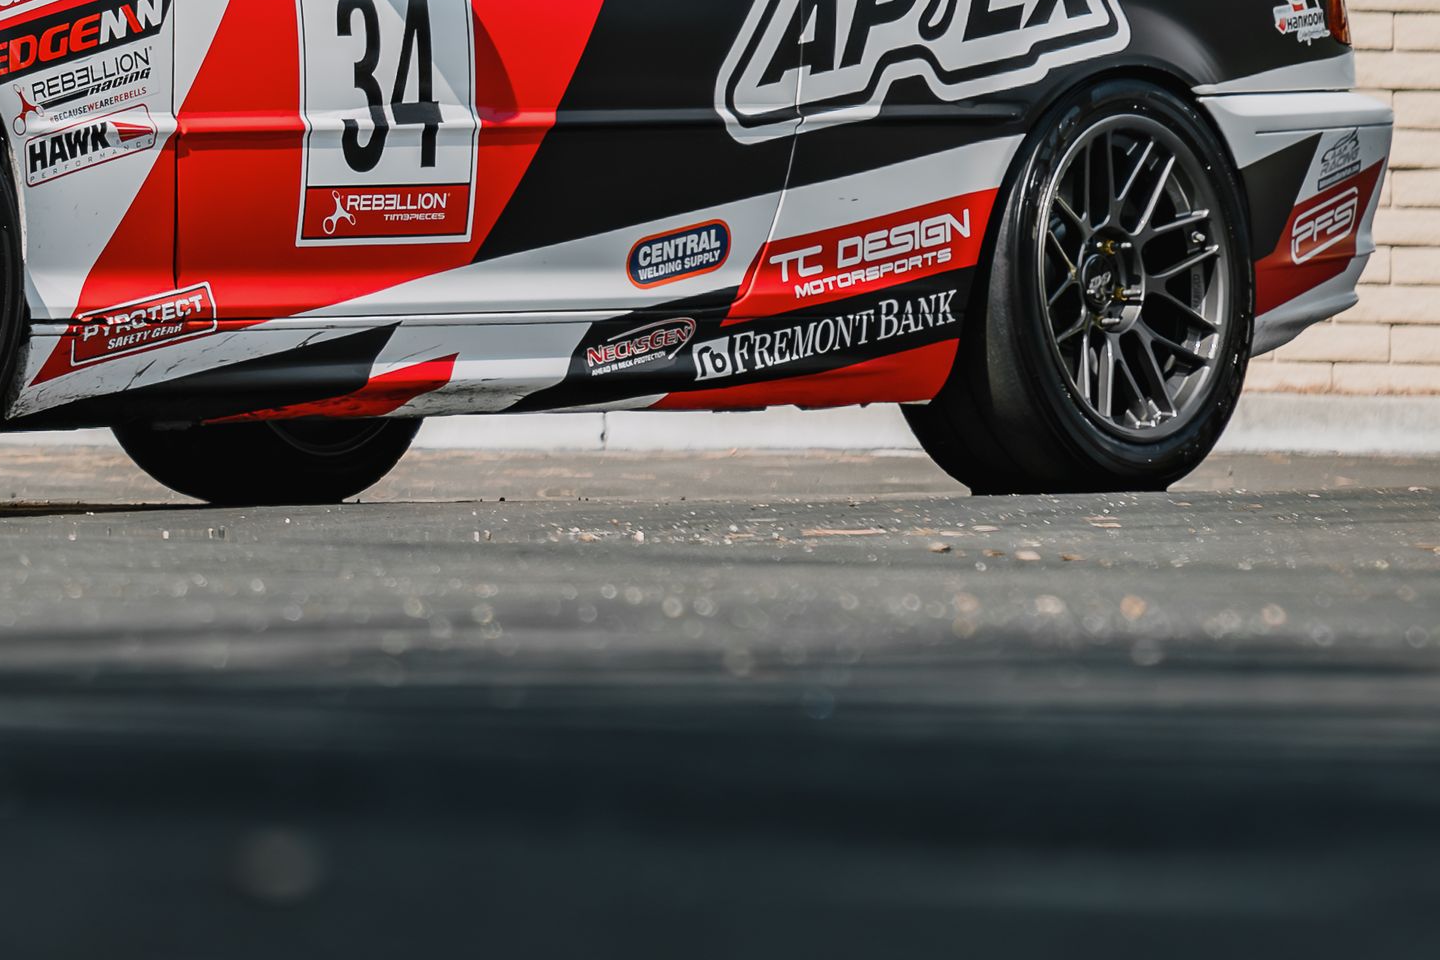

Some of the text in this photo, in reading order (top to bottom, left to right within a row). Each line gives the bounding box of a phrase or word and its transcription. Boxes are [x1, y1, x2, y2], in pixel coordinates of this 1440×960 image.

[29, 121, 111, 173] HAWK
[30, 135, 153, 182] PERFORMANCE
[638, 229, 721, 267] CENTRAL
[638, 249, 721, 281] WELDING SUPPLY
[769, 208, 972, 283] TC DESIGN
[794, 247, 953, 299] MOTORSPORTS
[82, 293, 204, 342] PYROTECT
[107, 322, 185, 350] SAFETY GEAR
[733, 308, 876, 375] FREMONT
[877, 288, 958, 340] BANK
[591, 350, 666, 377] AHEAD IN NECK PROTECTION
